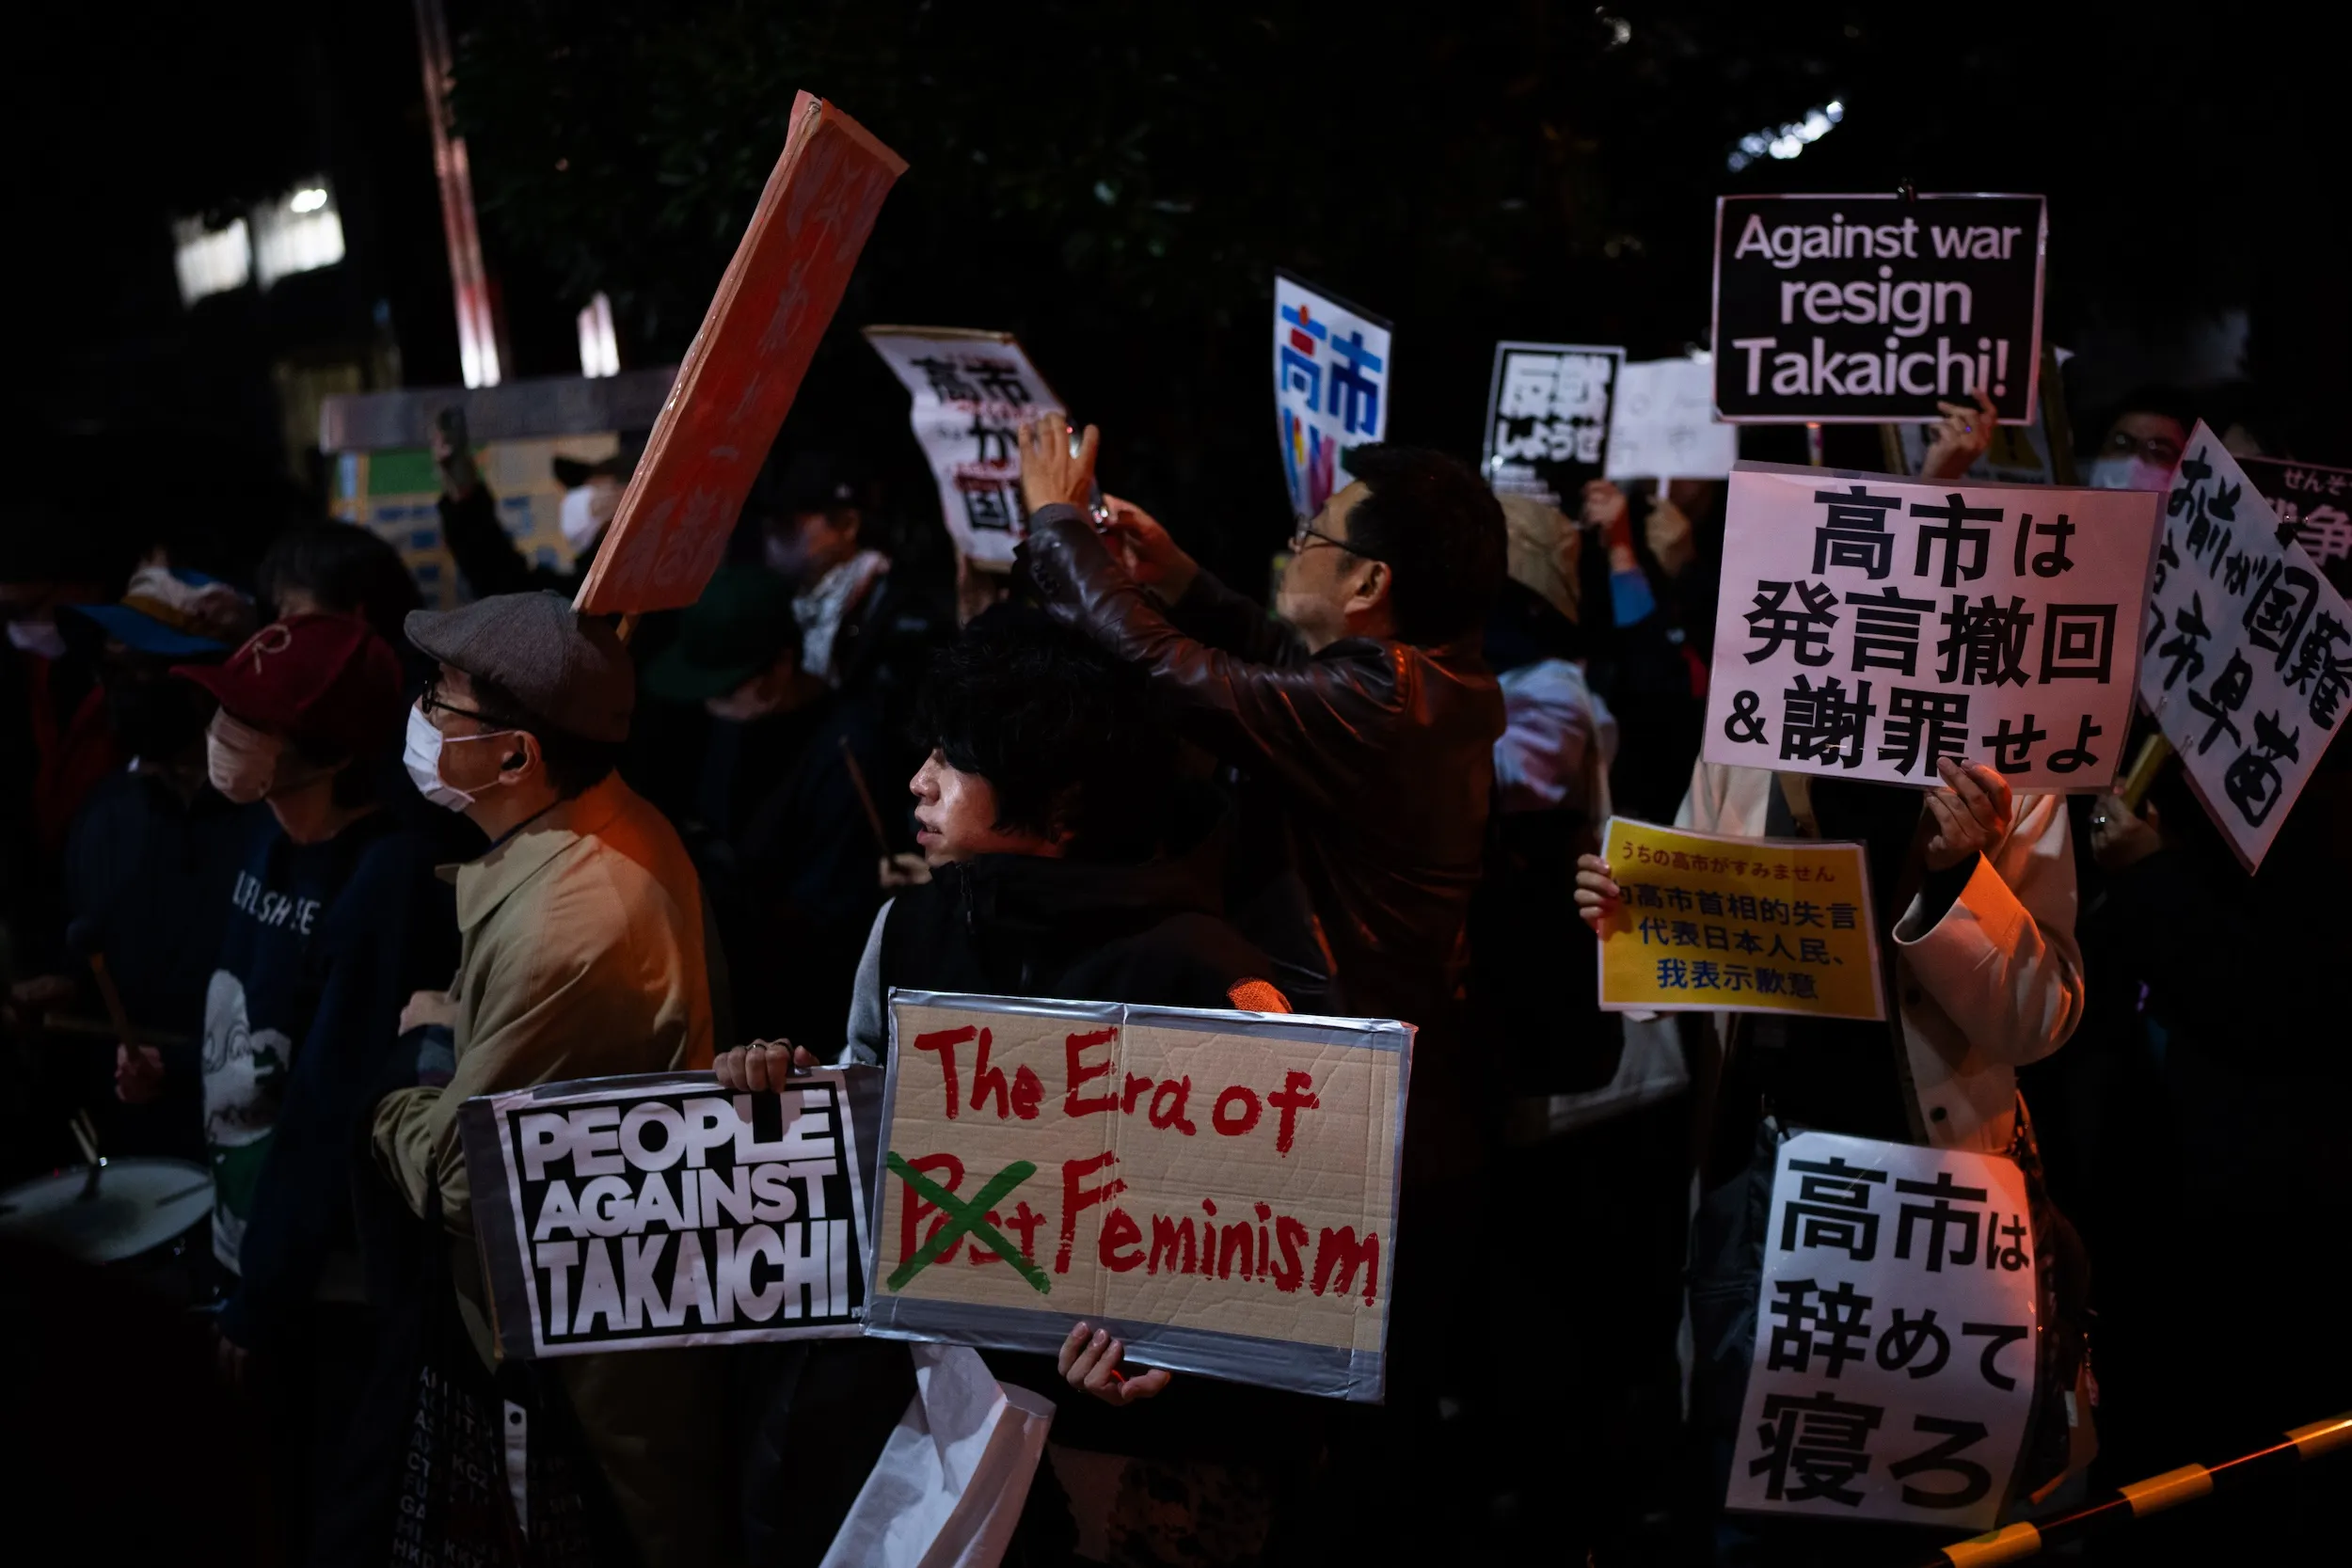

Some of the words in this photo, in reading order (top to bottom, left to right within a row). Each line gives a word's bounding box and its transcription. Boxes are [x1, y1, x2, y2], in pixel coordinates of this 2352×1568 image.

[1735, 213, 1919, 268] Against
[1931, 225, 2022, 259] war
[1782, 265, 1972, 338] resign
[1280, 303, 1383, 437] 高市
[1732, 336, 2010, 397] Takaichi!
[1811, 485, 2075, 588] 高市は
[1743, 579, 2119, 688] 発言撤回
[1724, 673, 2100, 777] &謝罪せよ
[1622, 841, 1836, 883] うちの高市がすみません
[518, 1088, 836, 1182] PEOPLE
[914, 1024, 1046, 1121] The
[1063, 1025, 1197, 1136] Era
[1212, 1069, 1319, 1158] of
[532, 1158, 838, 1241] AGAINST
[1054, 1149, 1380, 1307] Feminism
[1779, 1156, 2030, 1273] 高市は
[535, 1218, 849, 1336] TAKAICHI
[1766, 1277, 2028, 1392] 辞めて
[1748, 1391, 1993, 1510] 寝ろ
